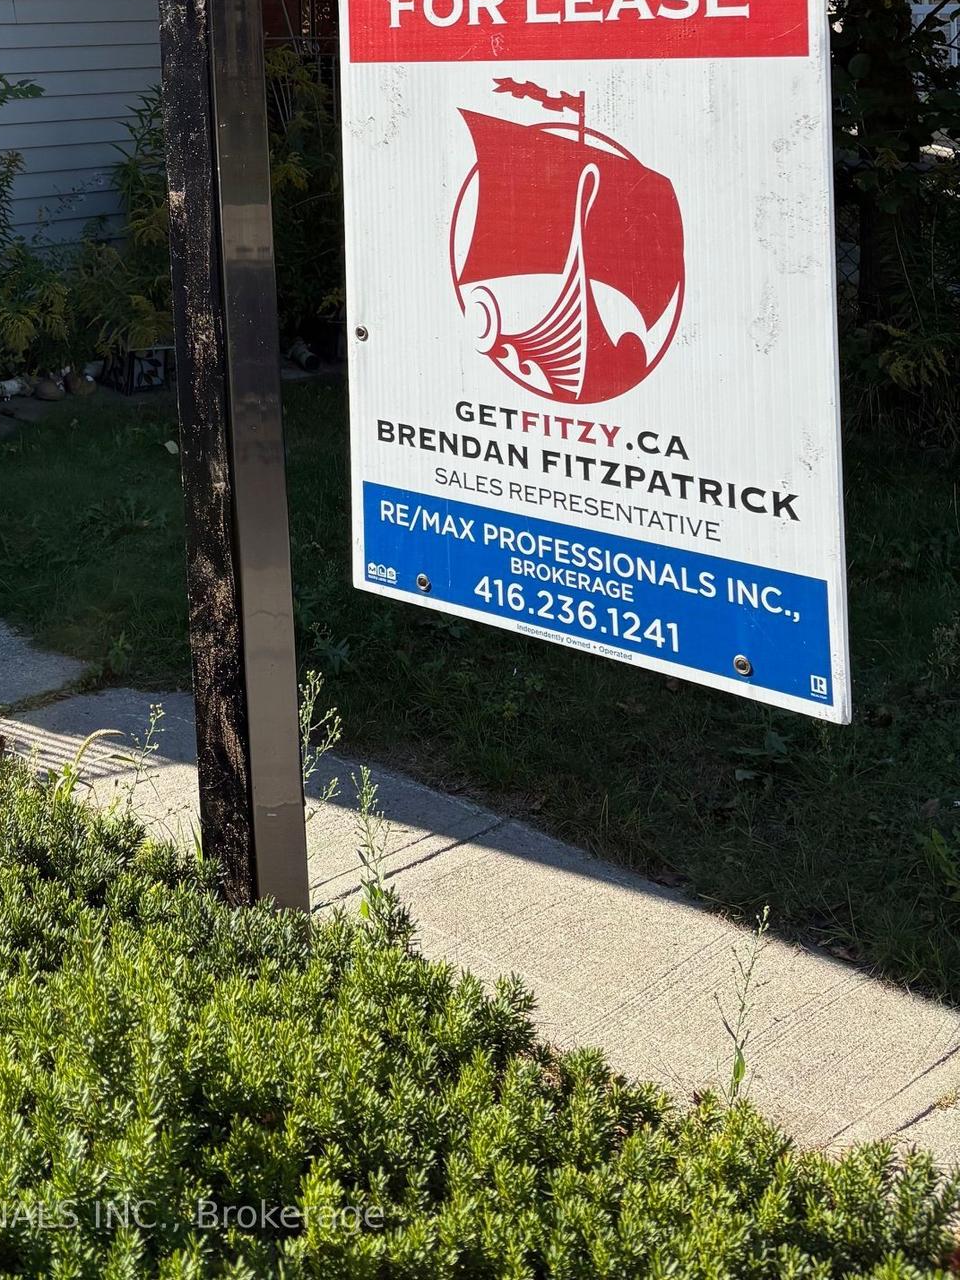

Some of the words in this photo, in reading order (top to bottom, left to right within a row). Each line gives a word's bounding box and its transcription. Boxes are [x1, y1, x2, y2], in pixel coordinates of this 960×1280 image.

[455, 400, 690, 461] GETFITZY.CA
[377, 419, 529, 470] BRENDAN
[542, 449, 800, 522] FITZPATRICK
[435, 467, 504, 496] SALES
[509, 482, 721, 542] REPRESENTATIVE
[380, 499, 476, 543] RE/MAX
[483, 522, 717, 598] PROFESSIONALS
[727, 577, 800, 622] INC.,
[510, 557, 634, 603] BROKERAGE
[474, 575, 680, 653] 416.236.1241
[516, 623, 565, 643] Independently
[565, 636, 591, 649] Owned
[598, 646, 633, 661] Operated
